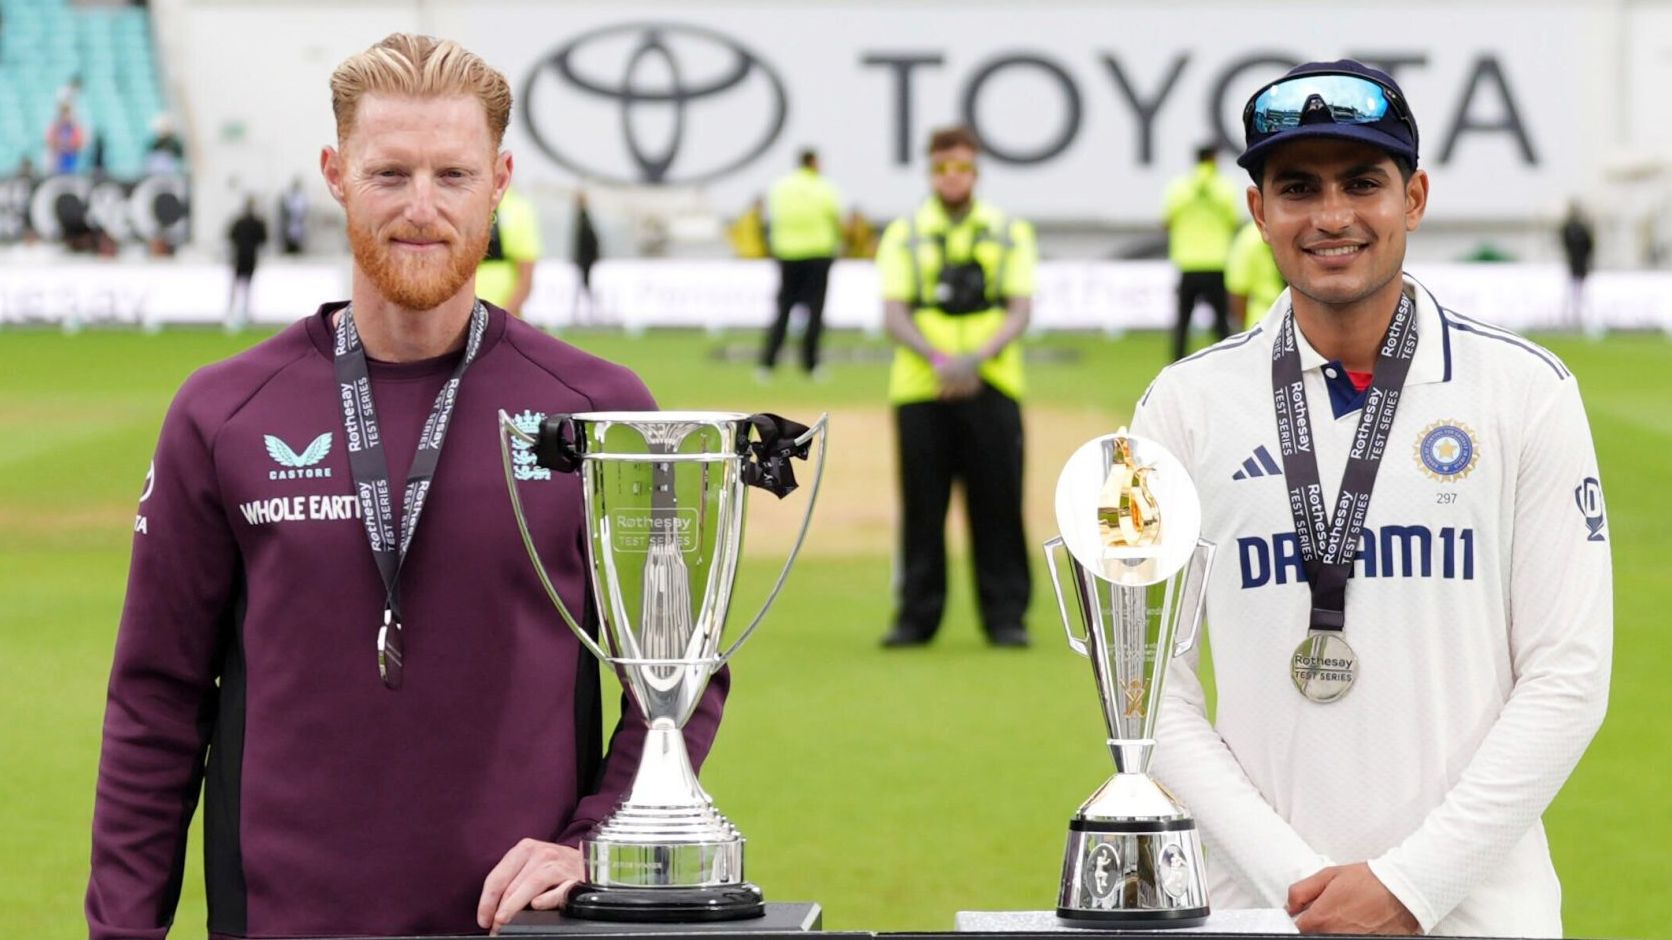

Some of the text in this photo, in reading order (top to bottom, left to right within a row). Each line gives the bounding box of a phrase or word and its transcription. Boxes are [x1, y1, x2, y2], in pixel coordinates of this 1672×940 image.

[1381, 291, 1409, 357] Rothesay
[1401, 334, 1417, 359] TEST
[341, 383, 362, 452] Rothesay
[358, 377, 380, 448] TEST SERIES
[430, 378, 460, 450] Rothesay
[1275, 388, 1293, 456] TEST SERIES
[1291, 381, 1311, 453] Rothesay
[1350, 387, 1384, 460] Rothesay
[1371, 390, 1399, 461] TEST SERIES
[269, 467, 332, 480] CASTORE
[1436, 493, 1458, 504] 297
[239, 497, 306, 525] WHOLE
[359, 482, 382, 552] Rothesay
[377, 480, 396, 552] TEST SERIES
[617, 515, 692, 531] Rothesay
[619, 536, 646, 546] TEST
[1290, 488, 1313, 562] TEST SERIES
[1322, 490, 1354, 564] Rothesay
[1341, 493, 1369, 565] TEST SERIES
[1236, 525, 1474, 589] DRAM11
[1295, 655, 1353, 670] Rothesay
[1295, 671, 1353, 682] TEST SERIES
